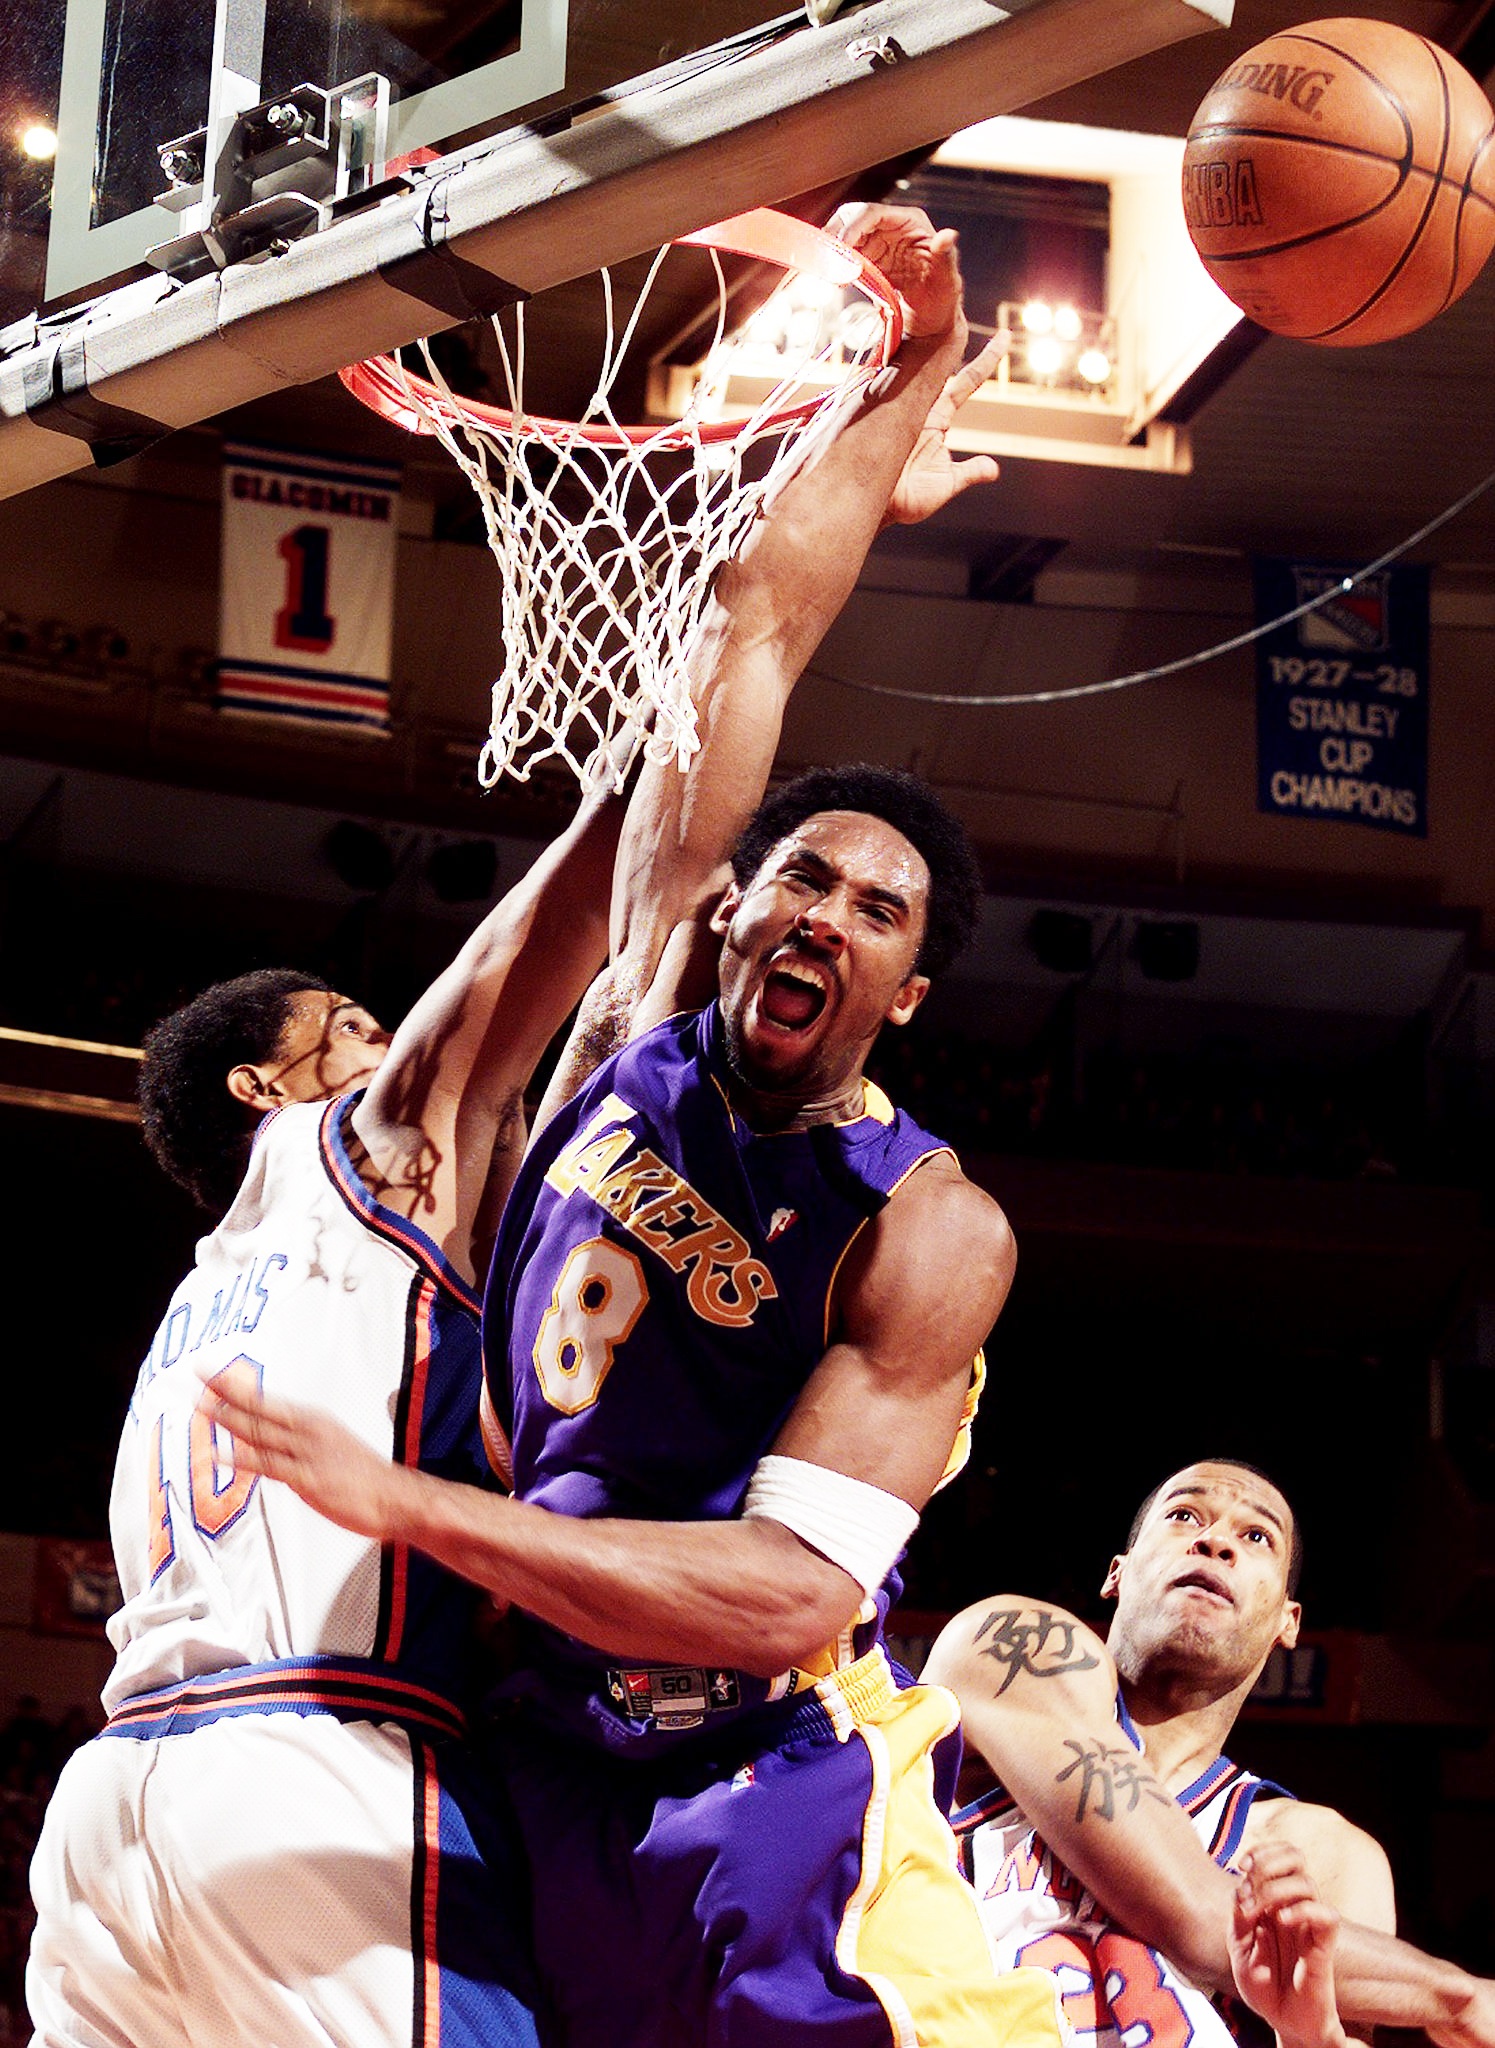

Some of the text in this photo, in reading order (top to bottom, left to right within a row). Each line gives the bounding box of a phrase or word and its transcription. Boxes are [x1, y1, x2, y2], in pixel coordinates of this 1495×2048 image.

[1184, 159, 1264, 228] NBA
[273, 522, 336, 656] 1
[1287, 696, 1400, 740] STANLEY
[1319, 737, 1374, 773] CUP
[1270, 769, 1418, 826] CHAMPIONS
[543, 1092, 779, 1328] LAKERS
[532, 1236, 650, 1416] 8
[660, 1675, 694, 1695] 50
